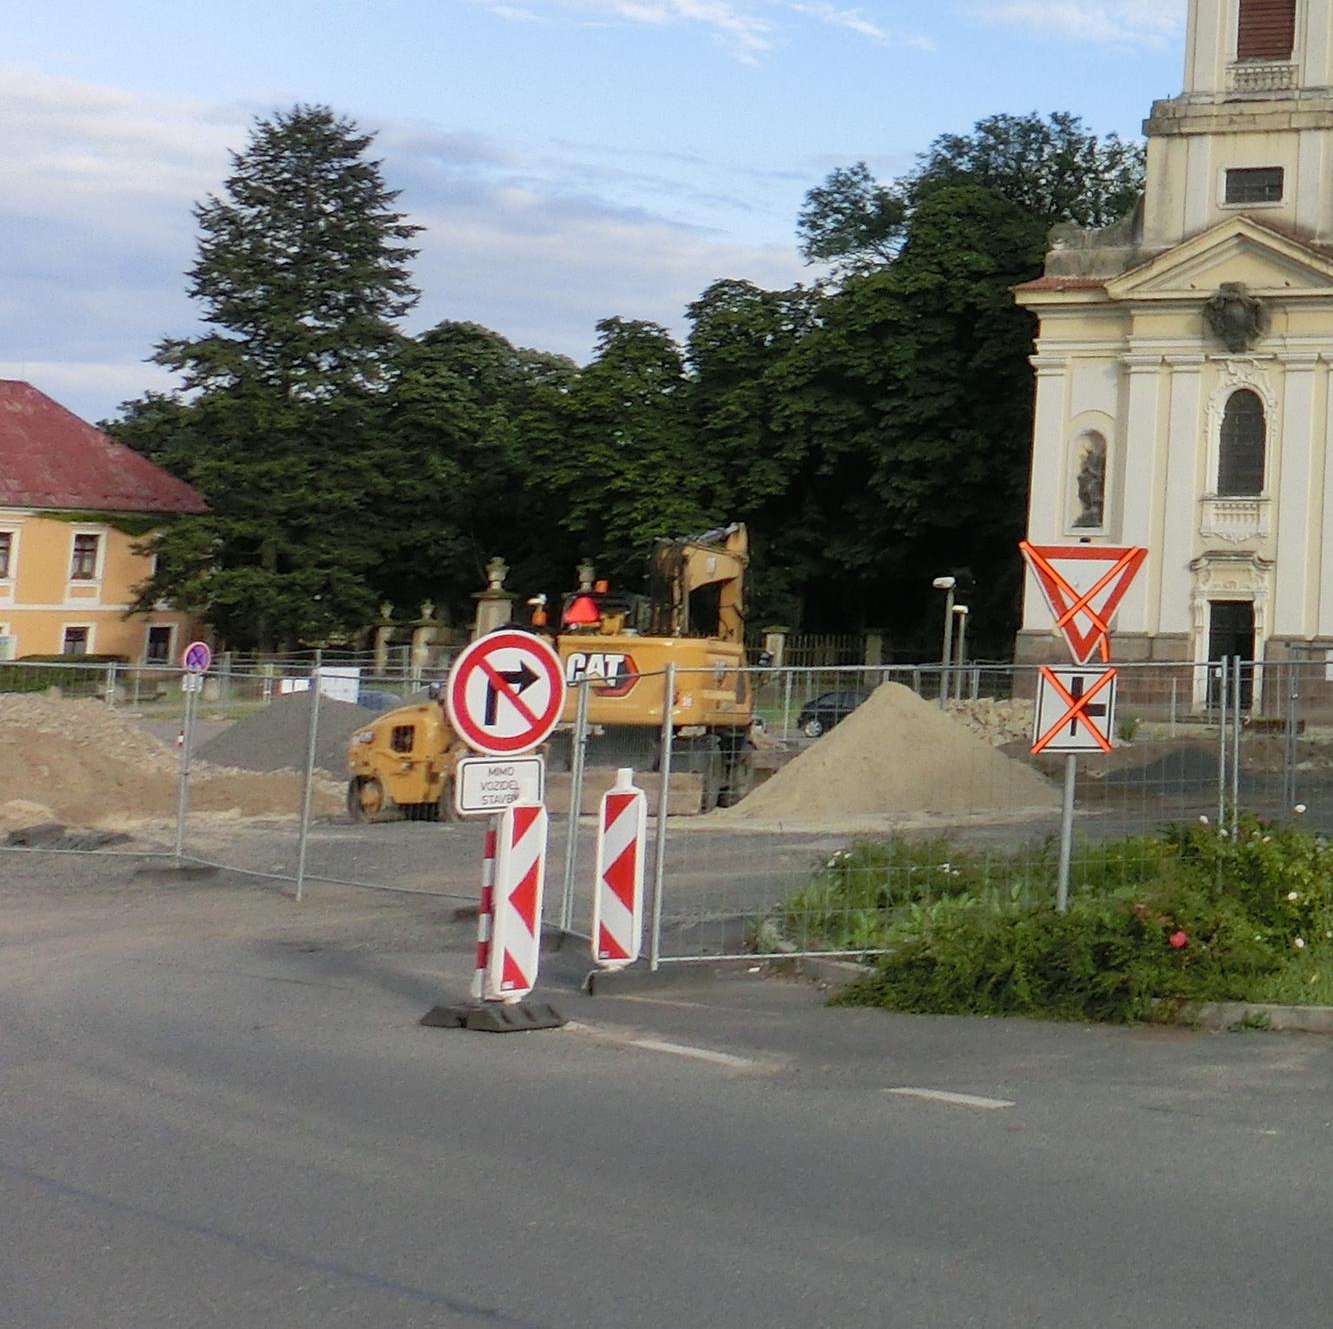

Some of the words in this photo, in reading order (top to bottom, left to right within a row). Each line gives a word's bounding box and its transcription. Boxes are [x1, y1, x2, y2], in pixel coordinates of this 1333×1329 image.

[566, 652, 625, 687] CAT
[488, 767, 514, 776] MIMO
[481, 780, 520, 791] VOZIDEL
